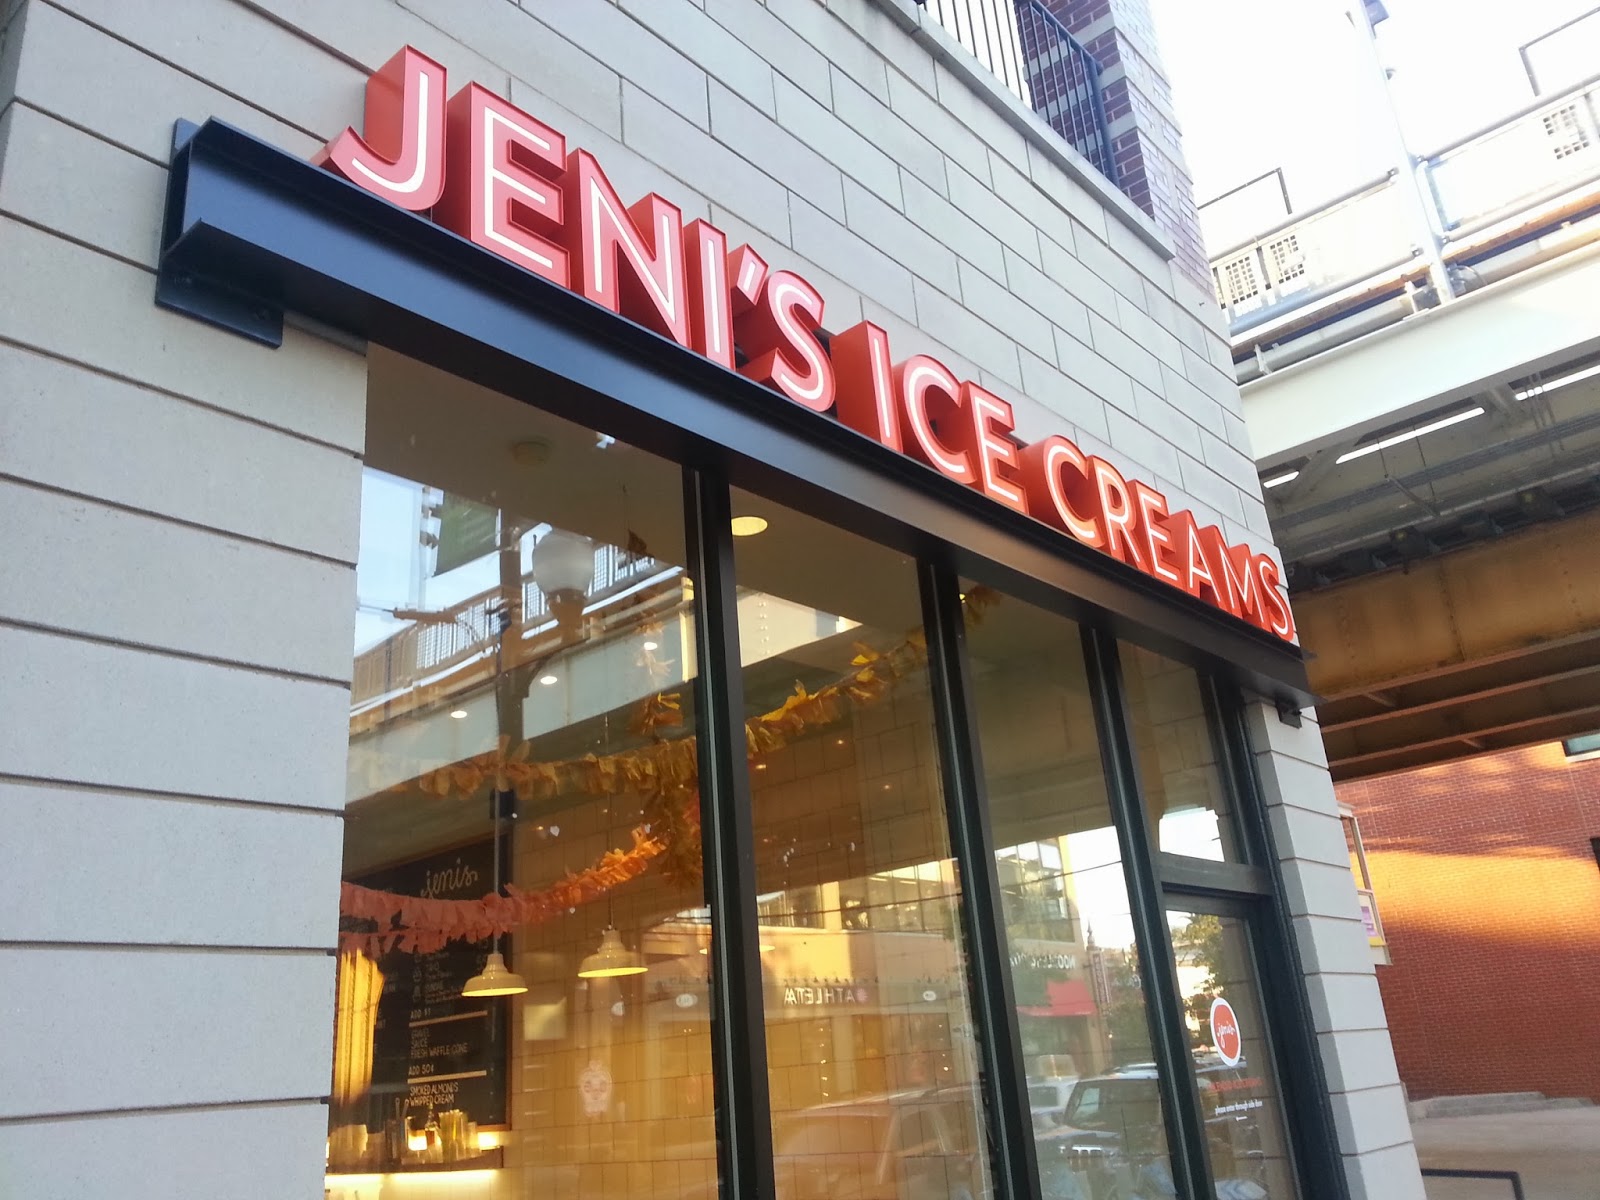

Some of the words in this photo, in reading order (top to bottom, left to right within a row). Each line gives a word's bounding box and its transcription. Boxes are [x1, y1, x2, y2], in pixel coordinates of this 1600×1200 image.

[322, 44, 836, 413] JENI'S
[845, 320, 1029, 515] ICE
[1030, 434, 1295, 643] CREAMS
[428, 1044, 450, 1057] WAFFLE
[408, 1065, 421, 1076] ADD
[409, 1083, 431, 1097] SMOKED
[430, 1081, 459, 1094] ALMONDS
[409, 1094, 434, 1107] WHIPPED
[433, 1092, 455, 1105] CREAM
